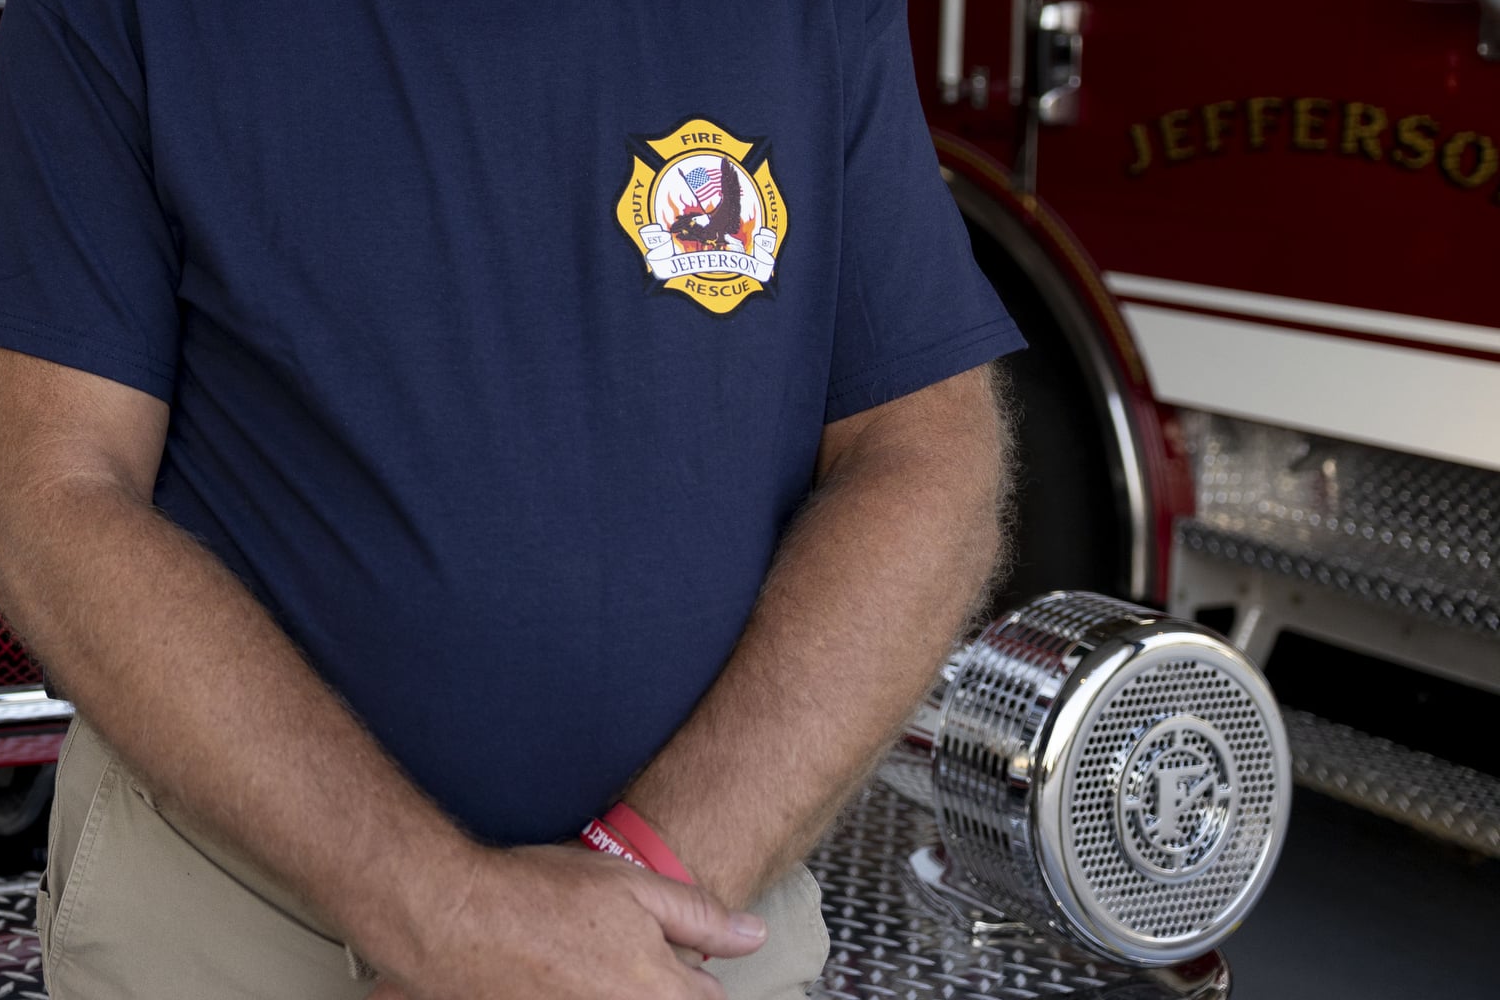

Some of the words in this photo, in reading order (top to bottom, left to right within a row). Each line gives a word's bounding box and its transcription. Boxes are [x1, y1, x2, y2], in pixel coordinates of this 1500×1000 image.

[680, 132, 723, 146] FIRE
[1127, 96, 1500, 206] JEFFERSO
[632, 179, 645, 226] DUTY
[764, 181, 778, 232] TRUST
[670, 253, 759, 276] JEFFERSON
[685, 279, 750, 297] RESCUE
[588, 826, 624, 857] HEART
